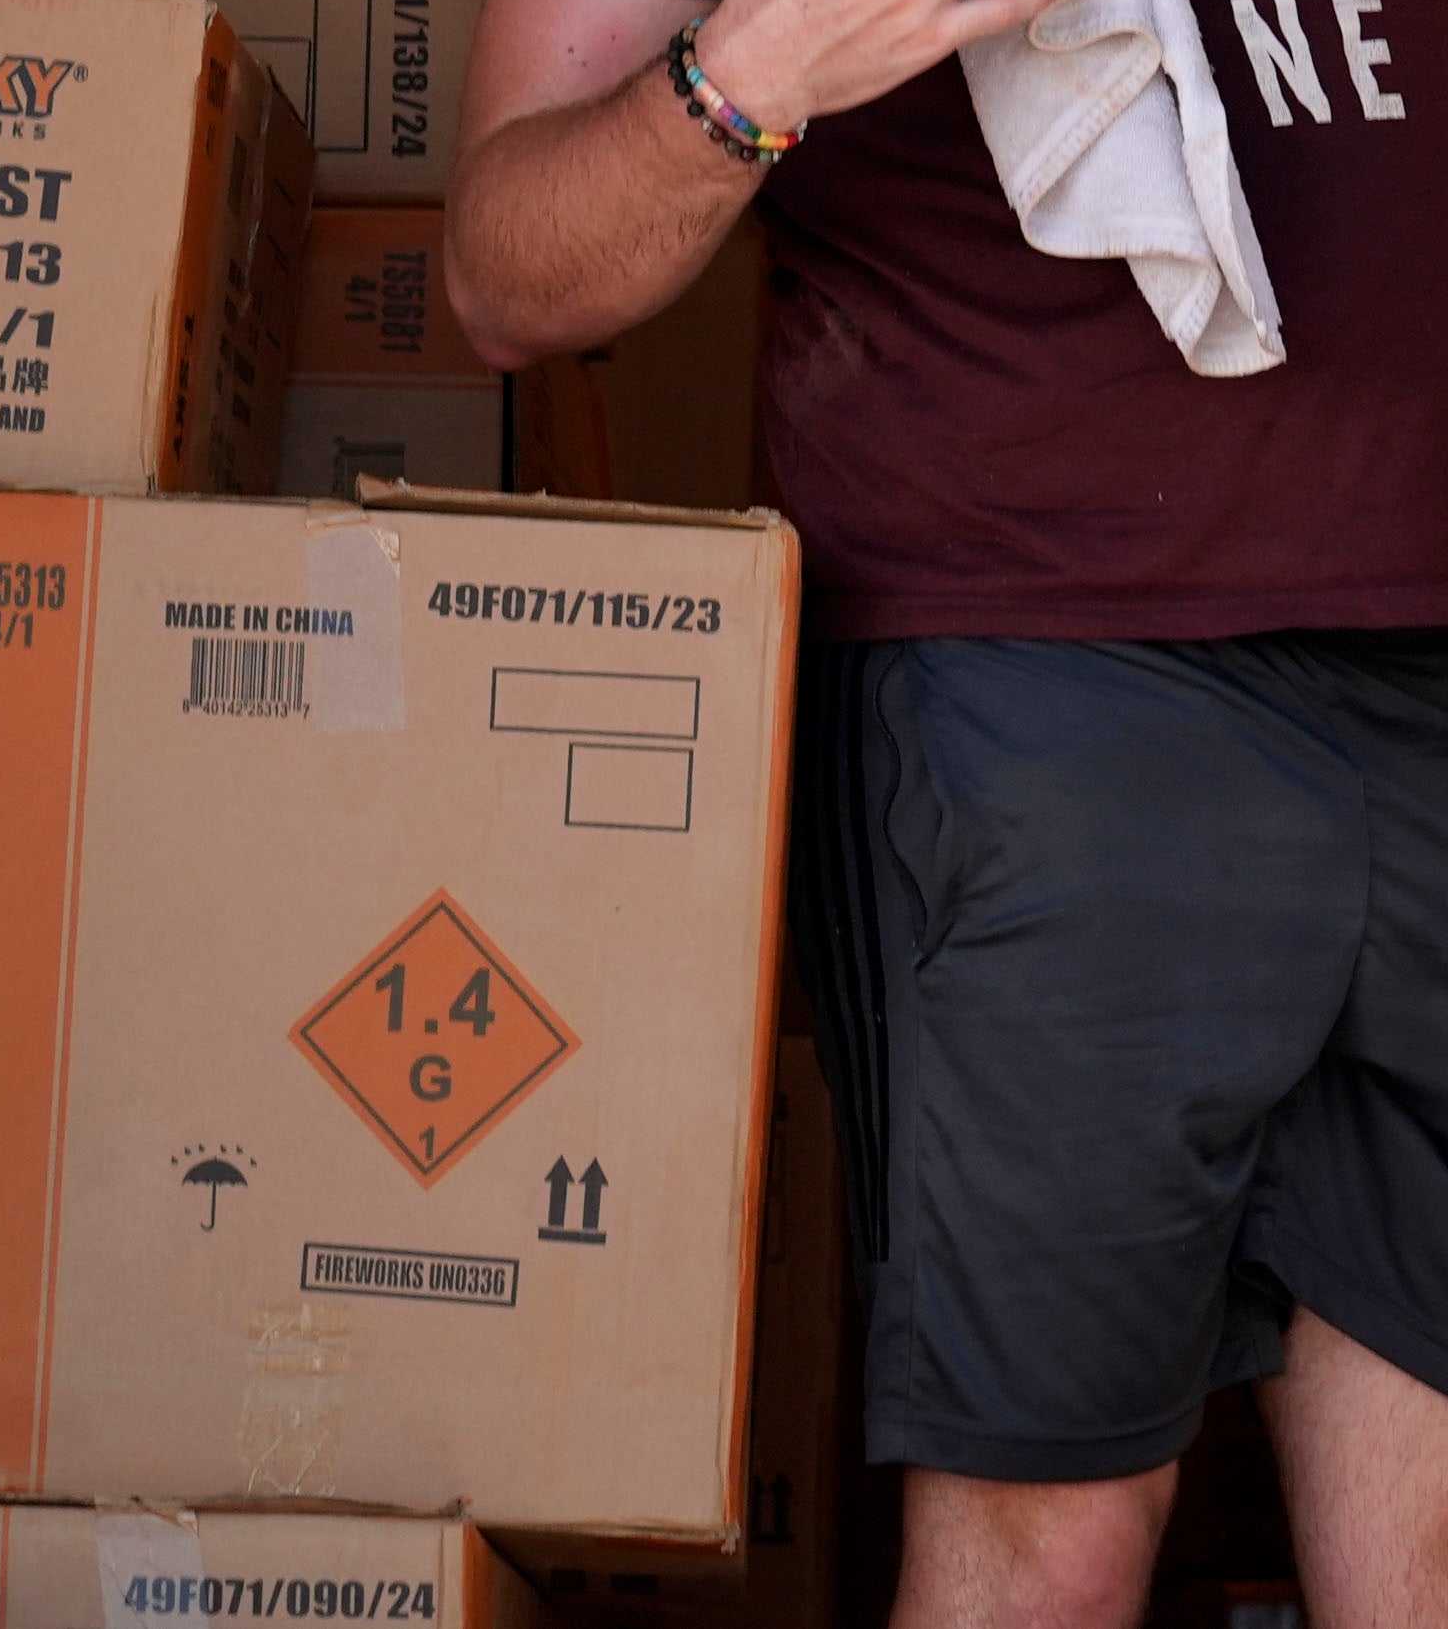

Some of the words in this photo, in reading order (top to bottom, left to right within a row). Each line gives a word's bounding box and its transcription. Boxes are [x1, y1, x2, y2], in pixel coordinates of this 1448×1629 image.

[165, 602, 235, 629] MADE
[242, 602, 270, 633] IN
[276, 608, 353, 635] CHINA
[429, 583, 720, 633] 49F071/115/23
[370, 959, 501, 1036] 1.4
[410, 1055, 451, 1102] G
[419, 1126, 434, 1160] 1
[309, 1254, 423, 1296] FIREWORKS
[424, 1264, 511, 1304] UN0336
[125, 1578, 435, 1619] 49F071/090/24
